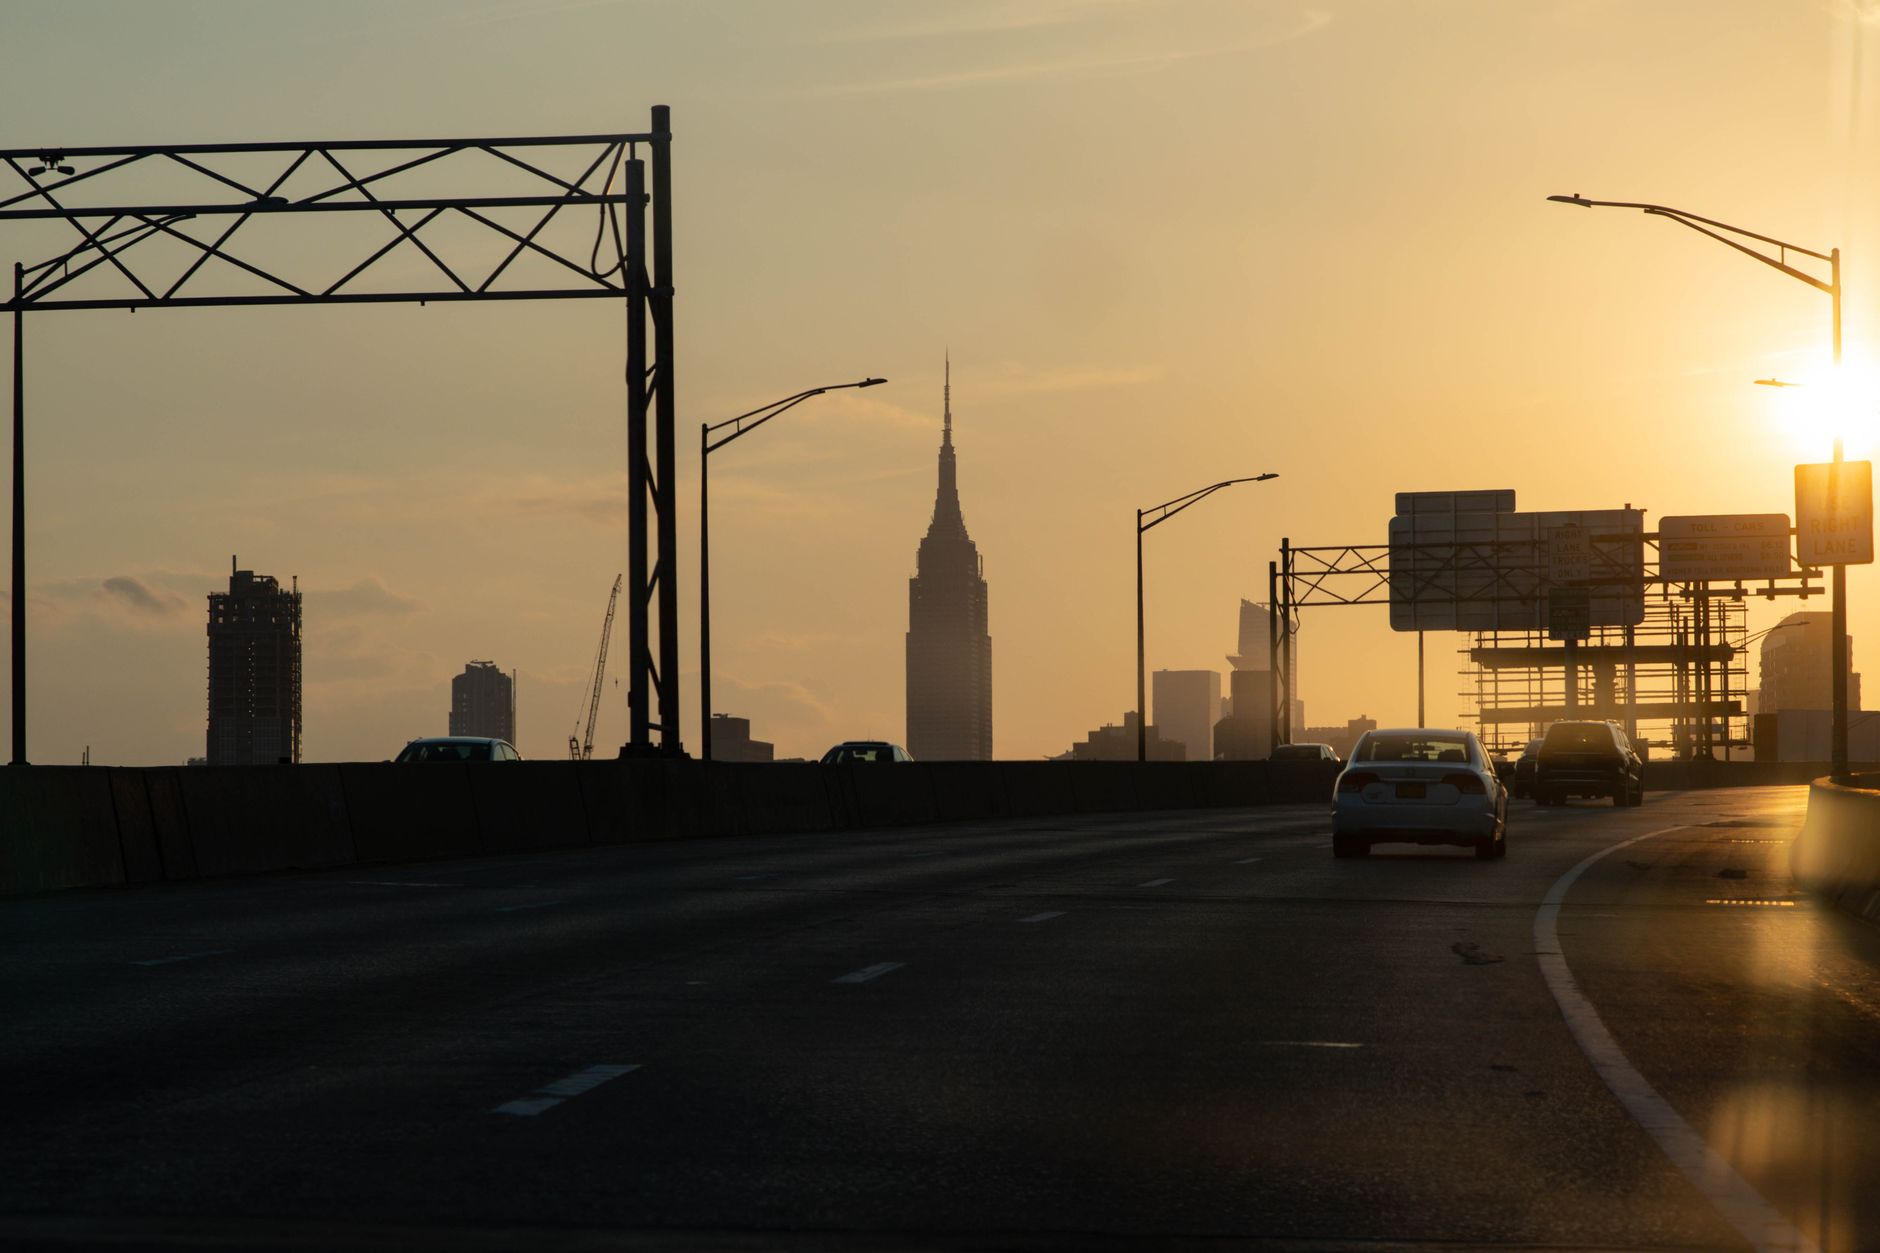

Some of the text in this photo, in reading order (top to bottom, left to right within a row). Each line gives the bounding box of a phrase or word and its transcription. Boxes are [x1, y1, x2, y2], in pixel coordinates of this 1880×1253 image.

[1690, 522, 1717, 532] TOLL
[1734, 522, 1765, 531] CARS
[1811, 516, 1859, 534] RIGHT
[1555, 530, 1583, 539] RIGHT
[1557, 543, 1580, 552] LANE
[1814, 538, 1857, 555] LANE
[1558, 567, 1583, 577] ONLY
